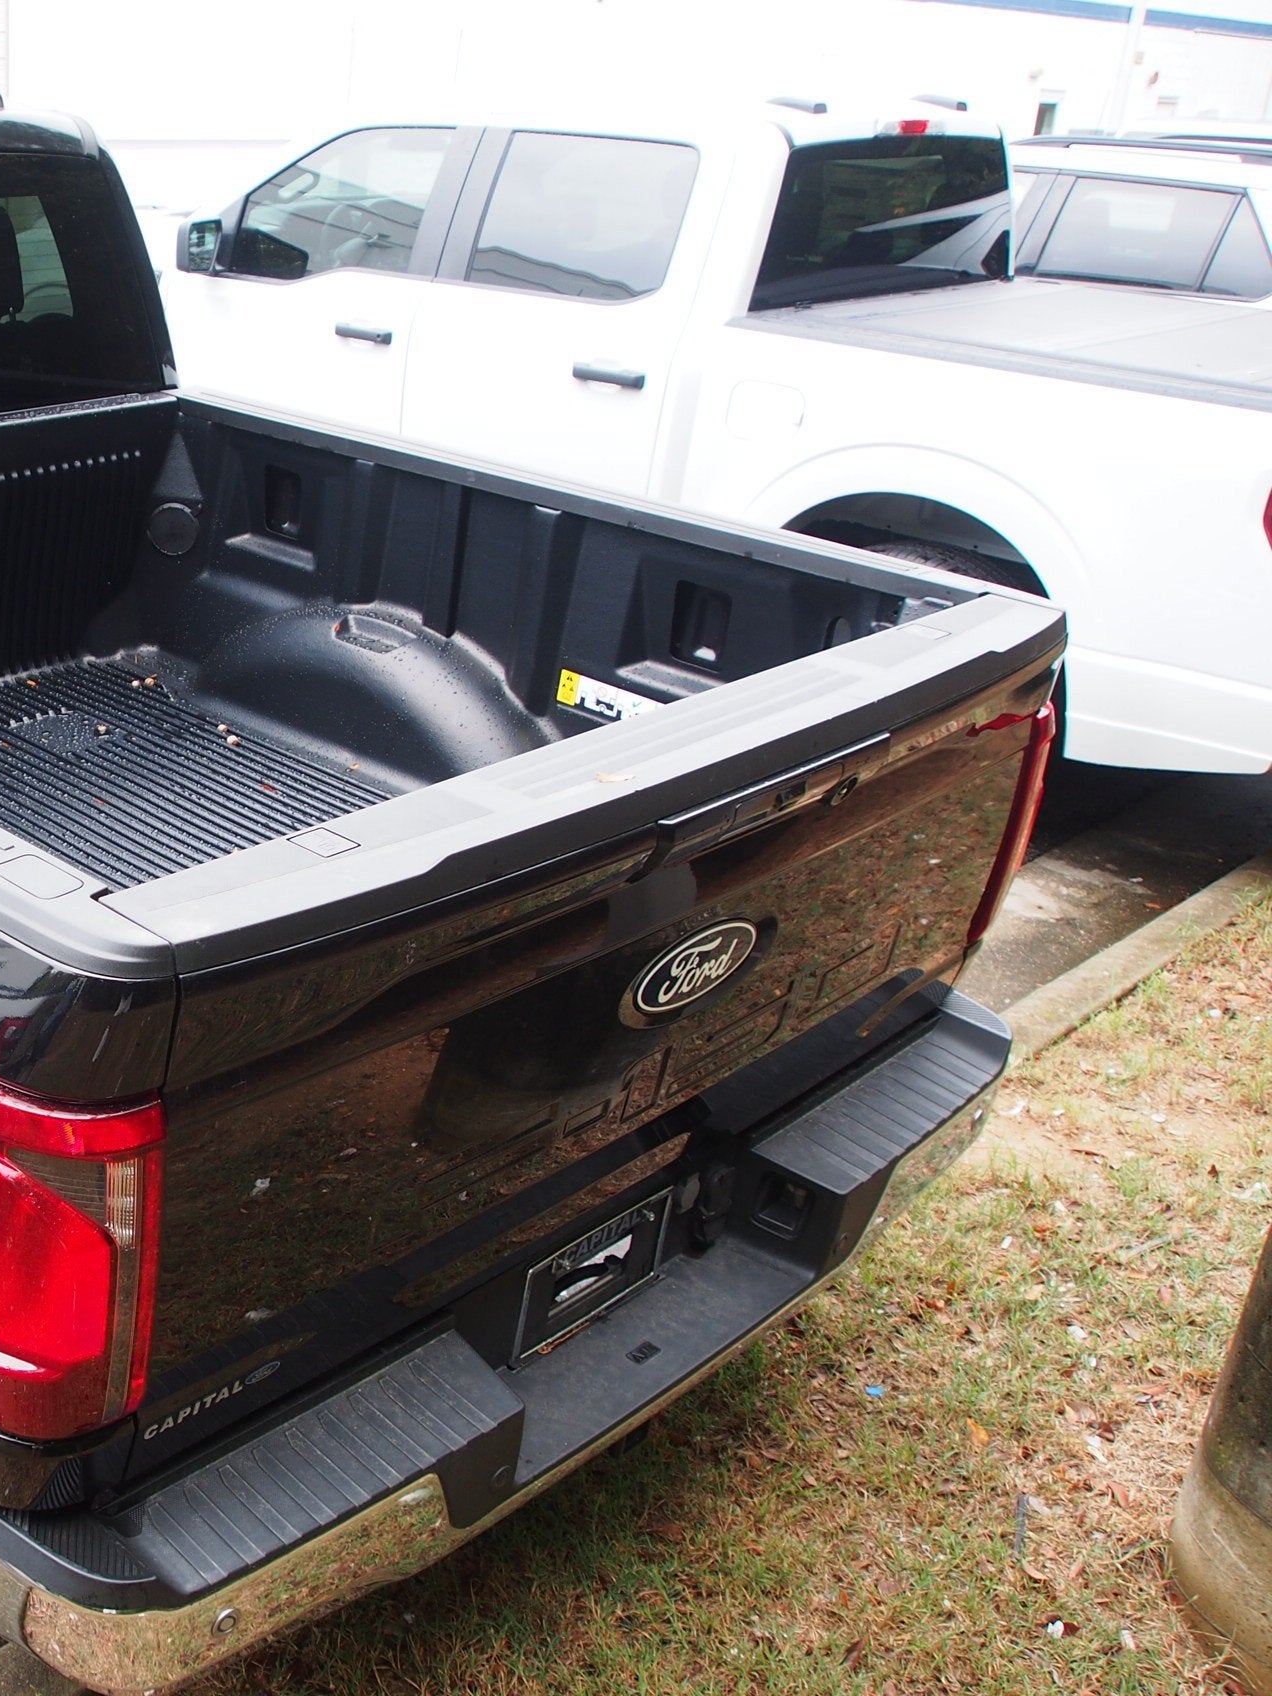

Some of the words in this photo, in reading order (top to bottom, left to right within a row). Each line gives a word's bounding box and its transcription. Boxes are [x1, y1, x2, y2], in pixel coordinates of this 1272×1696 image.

[658, 937, 738, 1003] Ford
[564, 1209, 642, 1264] CAPITAL
[144, 1380, 243, 1440] CAPITAL
